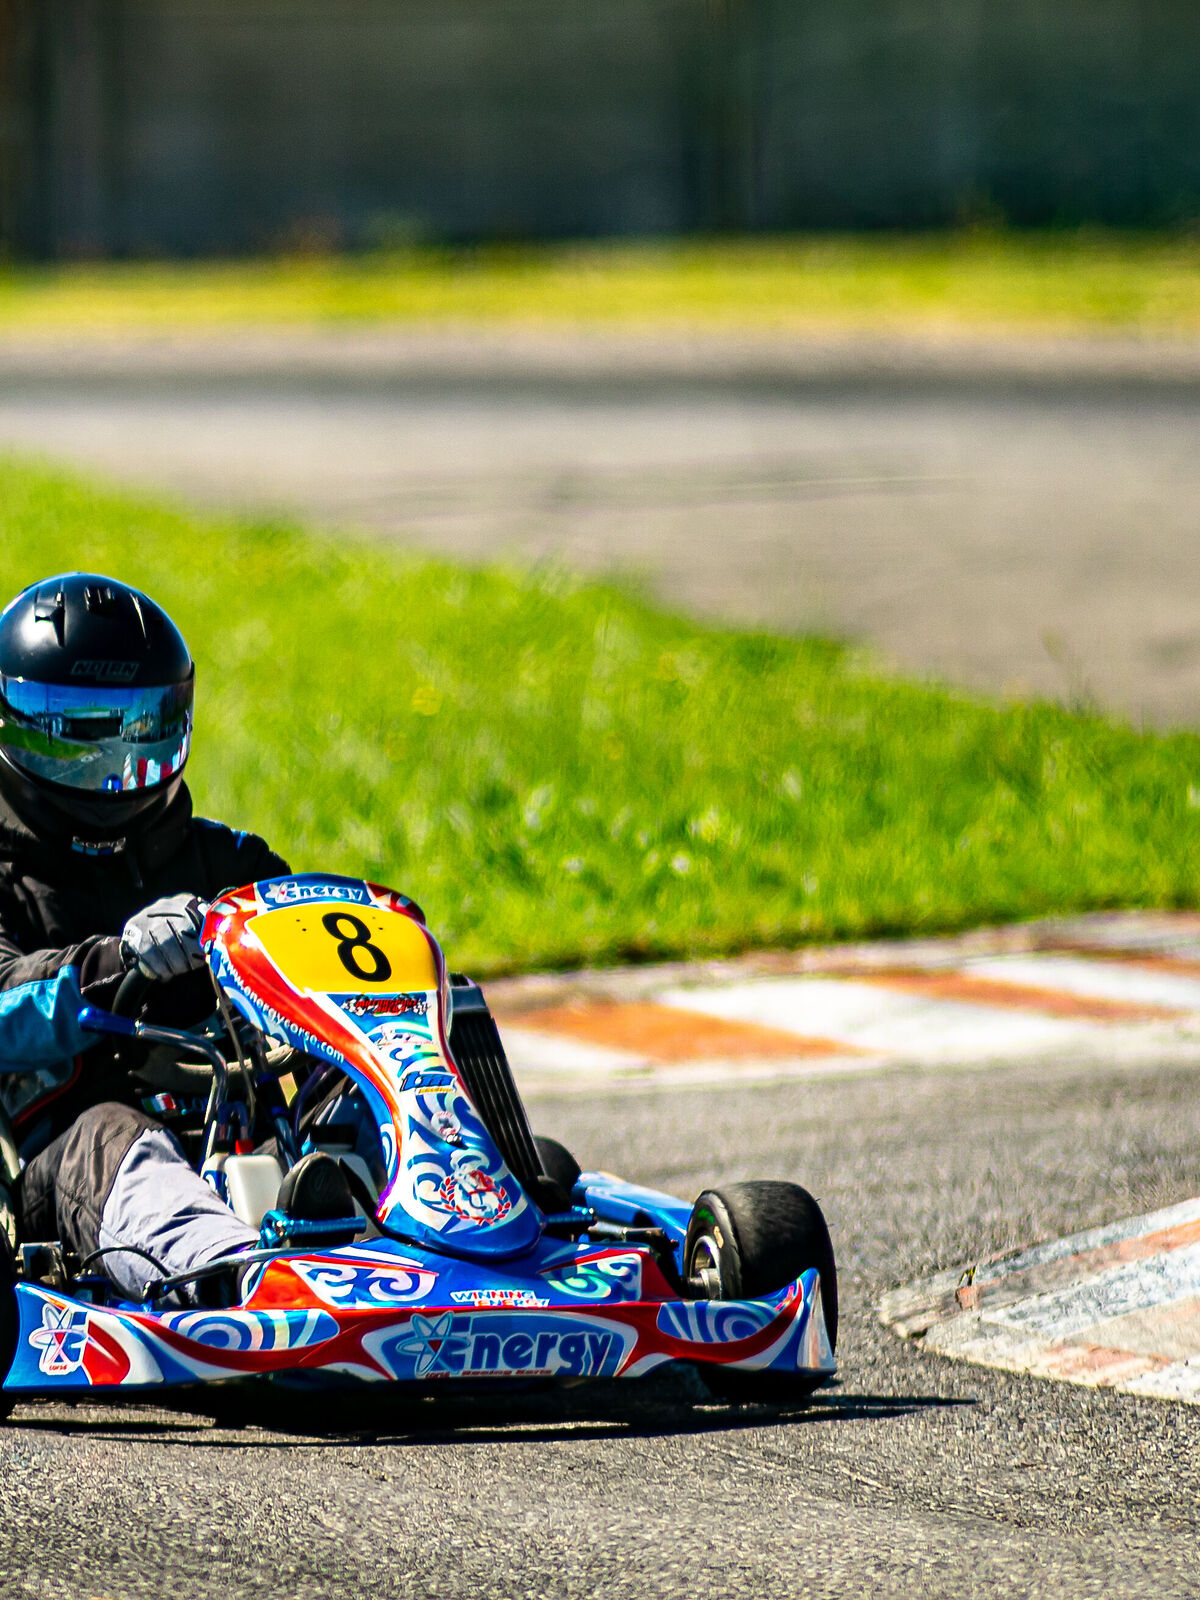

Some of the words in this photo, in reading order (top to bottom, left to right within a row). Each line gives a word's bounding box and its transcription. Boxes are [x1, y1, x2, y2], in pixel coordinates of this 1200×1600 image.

[285, 881, 364, 901] Energy
[322, 912, 392, 982] 8
[454, 1290, 535, 1301] WINNING
[428, 1316, 613, 1376] Energy
